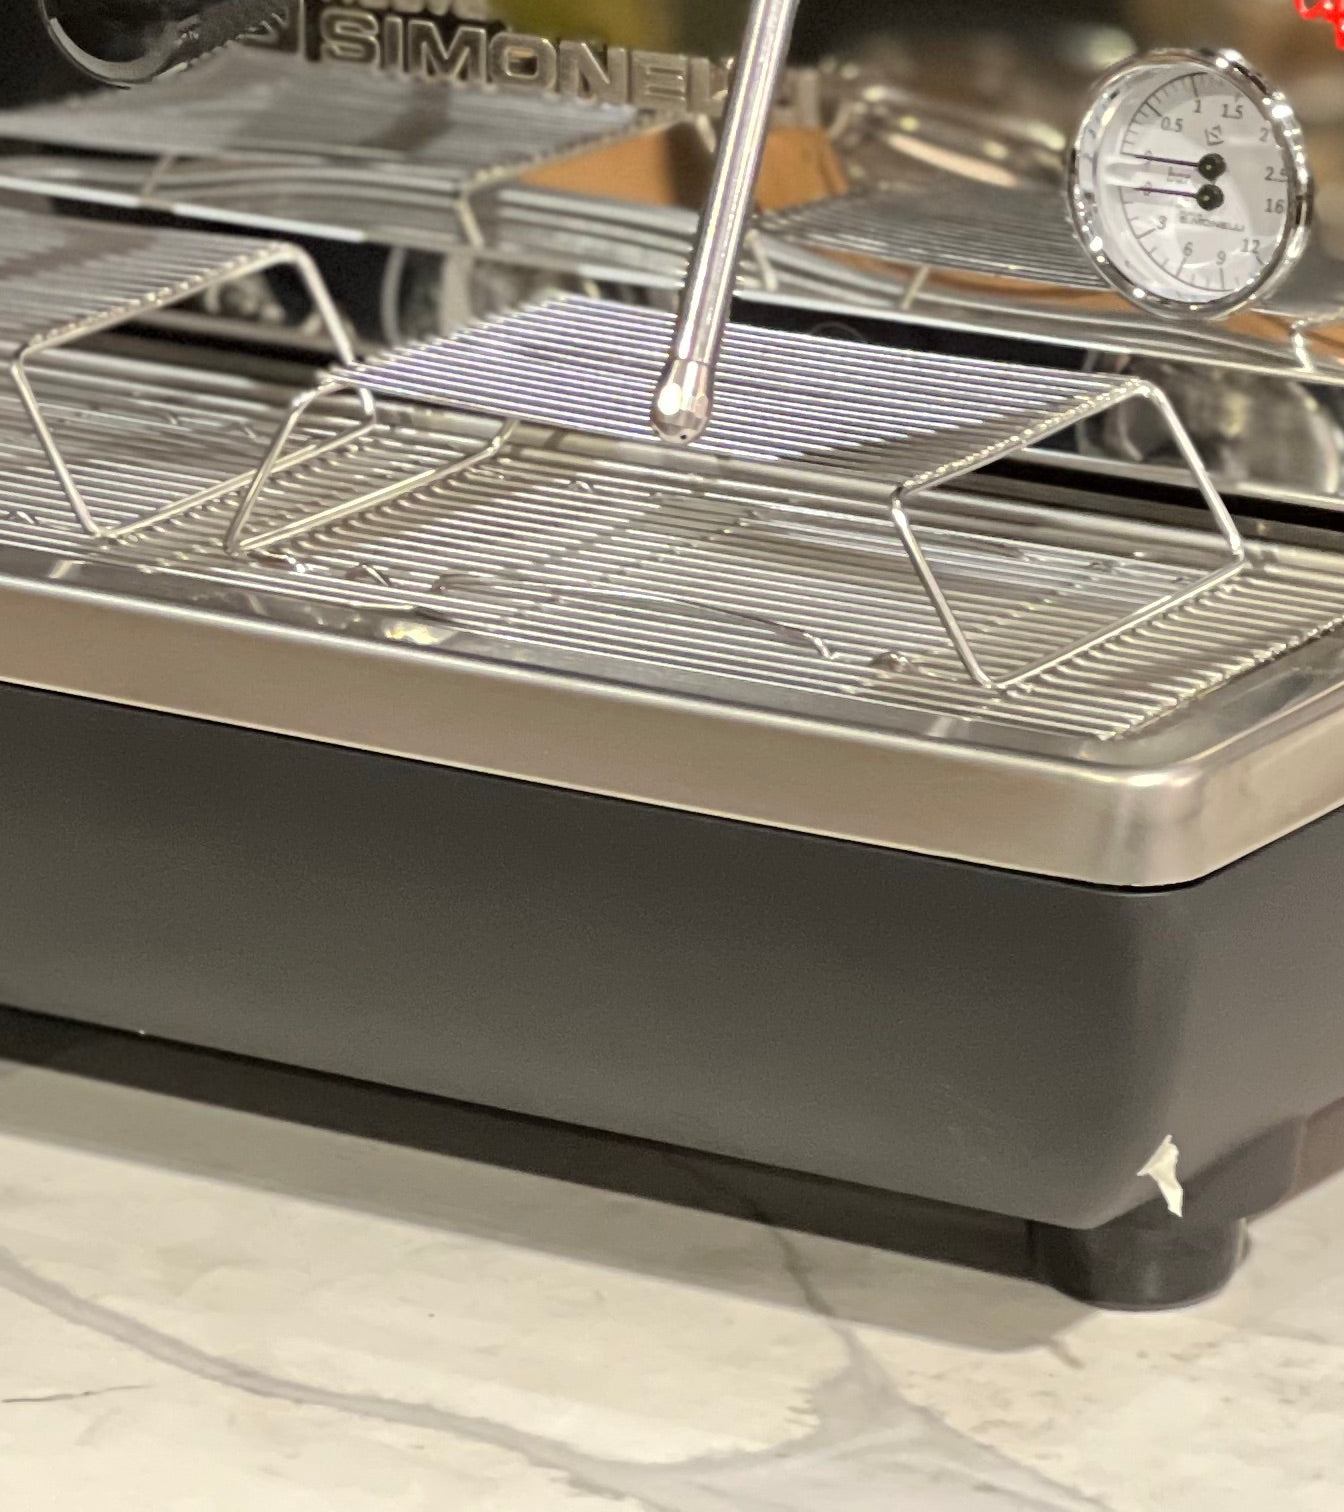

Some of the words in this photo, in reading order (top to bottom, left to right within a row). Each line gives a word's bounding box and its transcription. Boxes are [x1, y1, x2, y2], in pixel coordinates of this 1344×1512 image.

[1192, 99, 1202, 115] 1
[1221, 103, 1244, 120] 1.5
[1160, 116, 1184, 134] 0.5
[1259, 127, 1269, 143] 2
[1264, 165, 1289, 183] 2.5
[1263, 197, 1285, 214] 16
[1157, 215, 1168, 231] 3
[1183, 241, 1194, 257] 6
[1241, 239, 1261, 255] 12
[1216, 250, 1227, 266] 9
